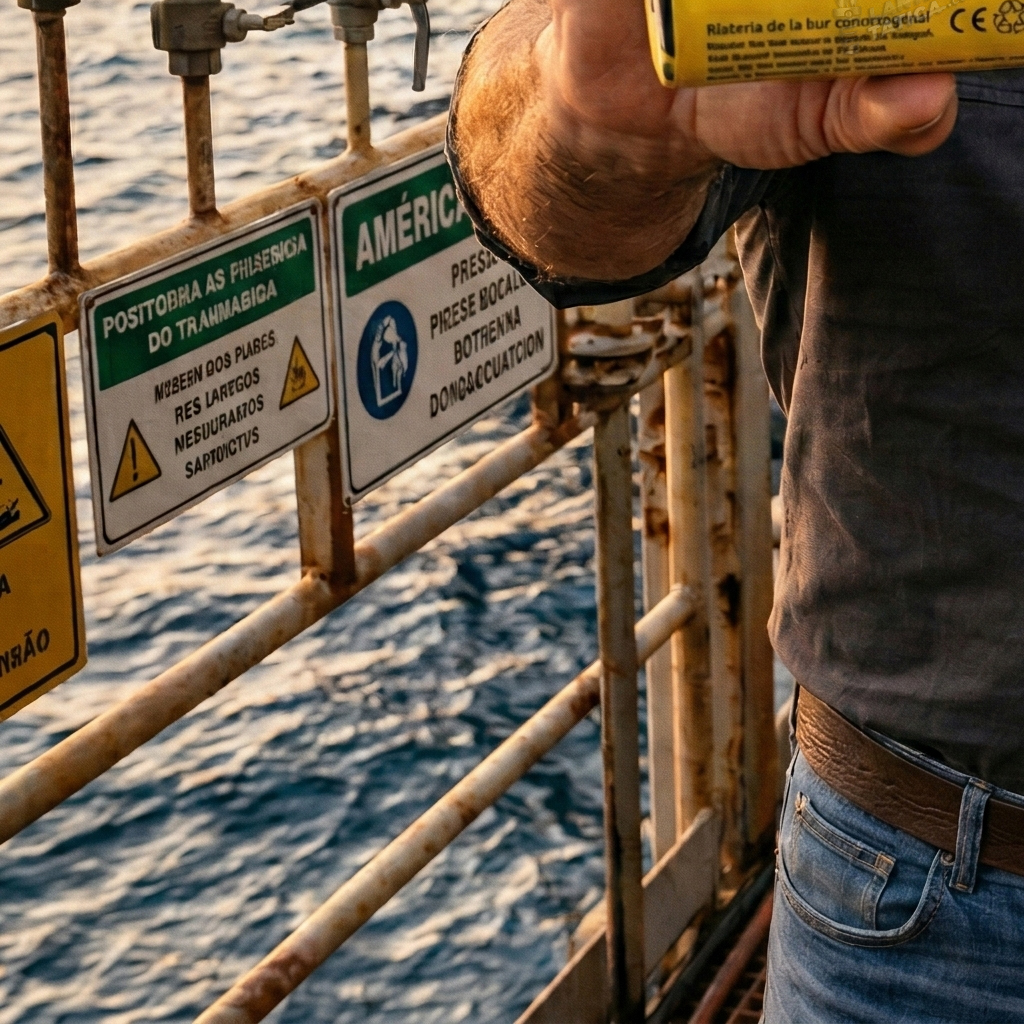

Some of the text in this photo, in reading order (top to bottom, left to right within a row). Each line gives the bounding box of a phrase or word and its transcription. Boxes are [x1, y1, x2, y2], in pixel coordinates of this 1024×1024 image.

[767, 19, 785, 32] de
[205, 268, 226, 297] AS
[148, 328, 173, 354] DO
[174, 397, 202, 425] RES
